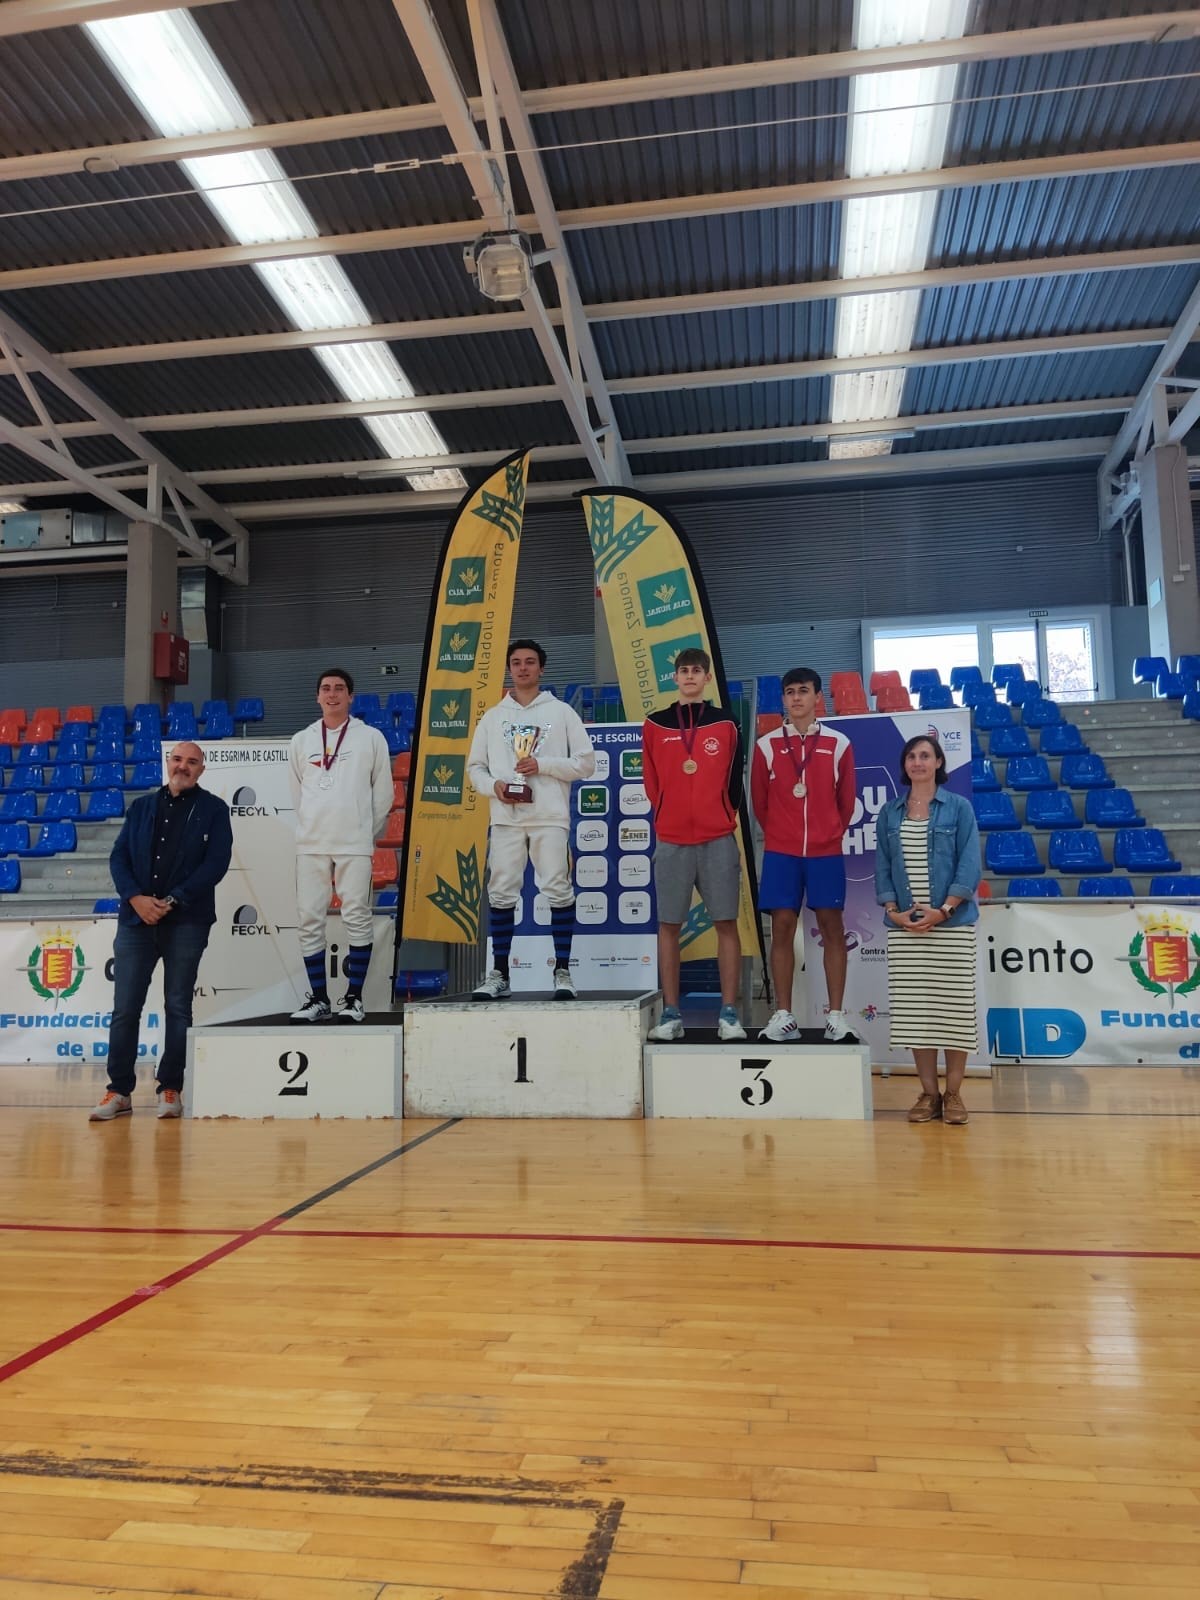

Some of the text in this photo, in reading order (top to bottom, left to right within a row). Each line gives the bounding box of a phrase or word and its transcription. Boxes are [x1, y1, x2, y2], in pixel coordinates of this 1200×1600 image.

[942, 731, 961, 740] VCE
[210, 751, 219, 762] DE
[221, 751, 250, 762] ESGRIMA
[252, 750, 262, 761] DE
[263, 750, 289, 762] CASTILL
[230, 806, 270, 817] FECYL
[231, 925, 271, 936] FECYL
[860, 947, 886, 955] Contra
[988, 935, 1094, 974] iento
[56, 1041, 84, 1057] de
[509, 1037, 534, 1083] 1
[277, 1051, 309, 1096] 2
[740, 1058, 773, 1106] 3
